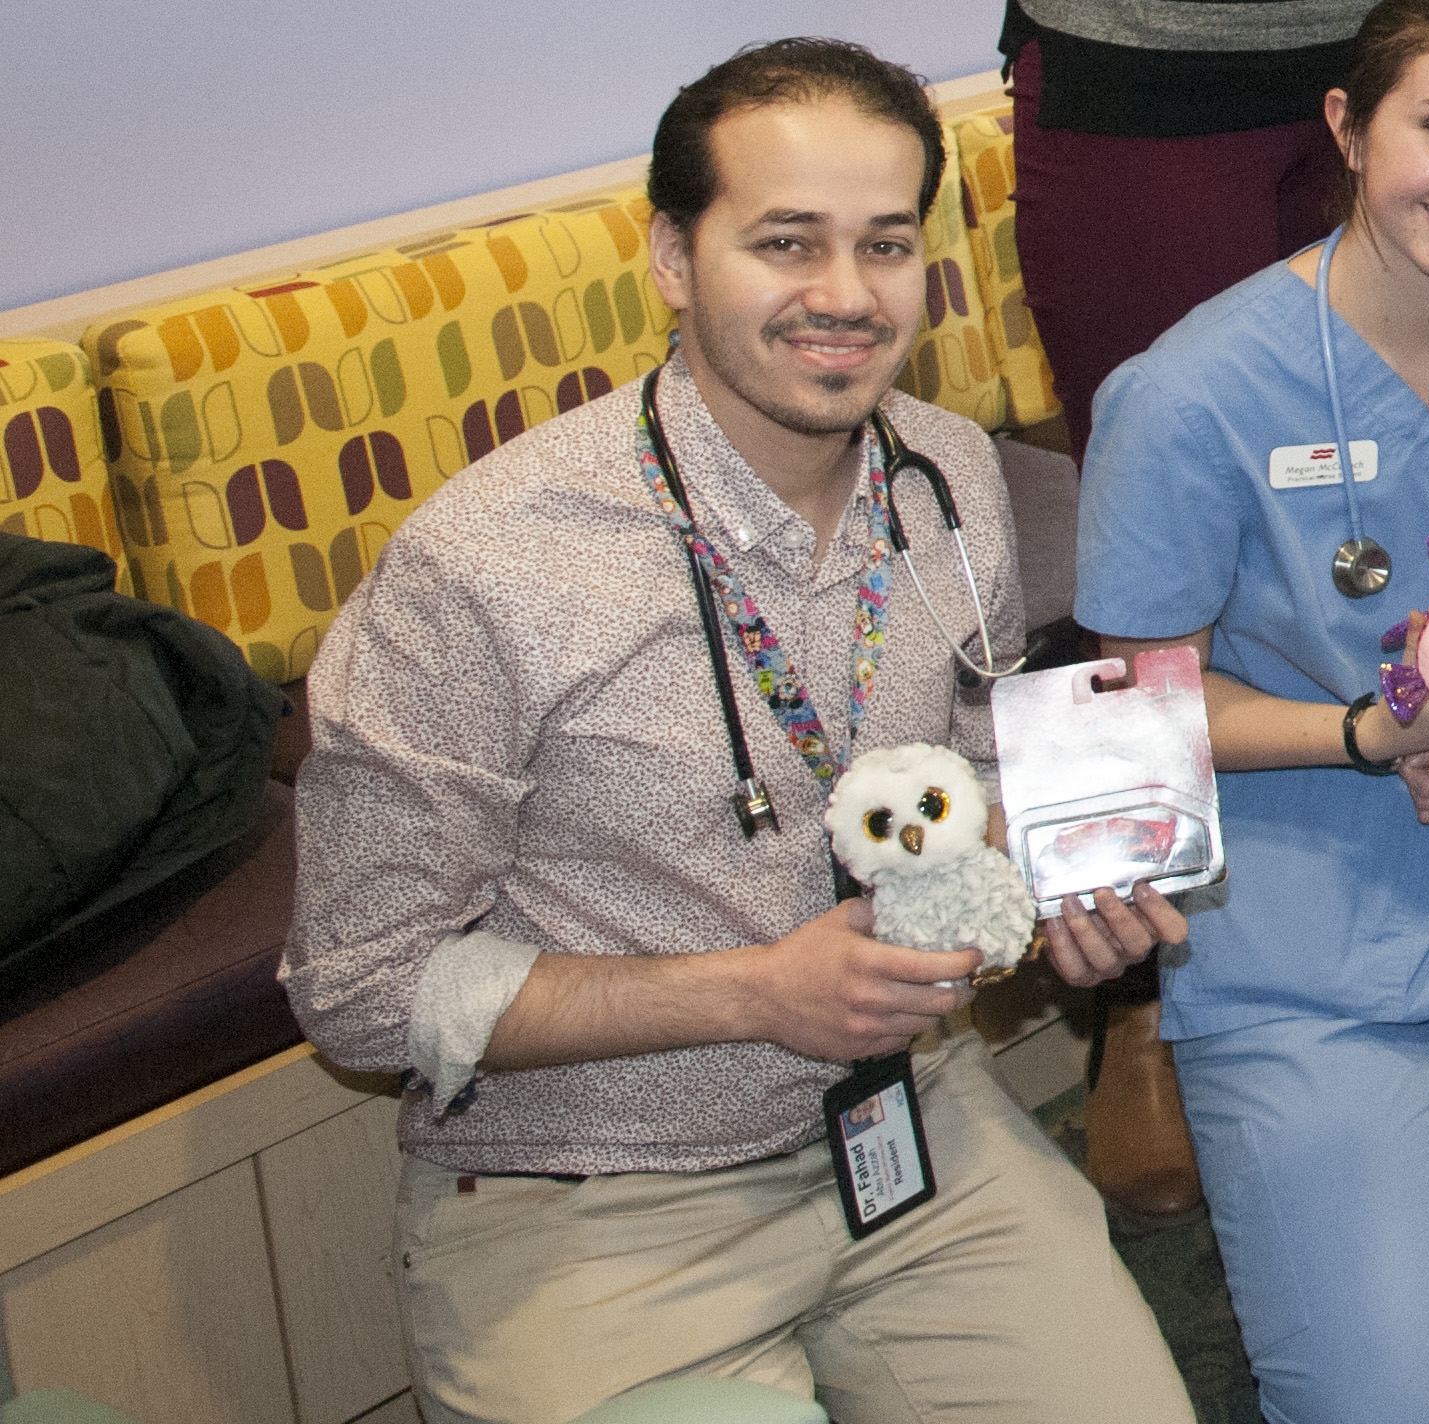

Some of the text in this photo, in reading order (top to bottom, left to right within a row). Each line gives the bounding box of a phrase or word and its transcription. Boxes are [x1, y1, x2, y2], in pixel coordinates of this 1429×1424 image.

[850, 1142, 877, 1218] Dr. Fahad
[886, 1138, 904, 1186] Resident
